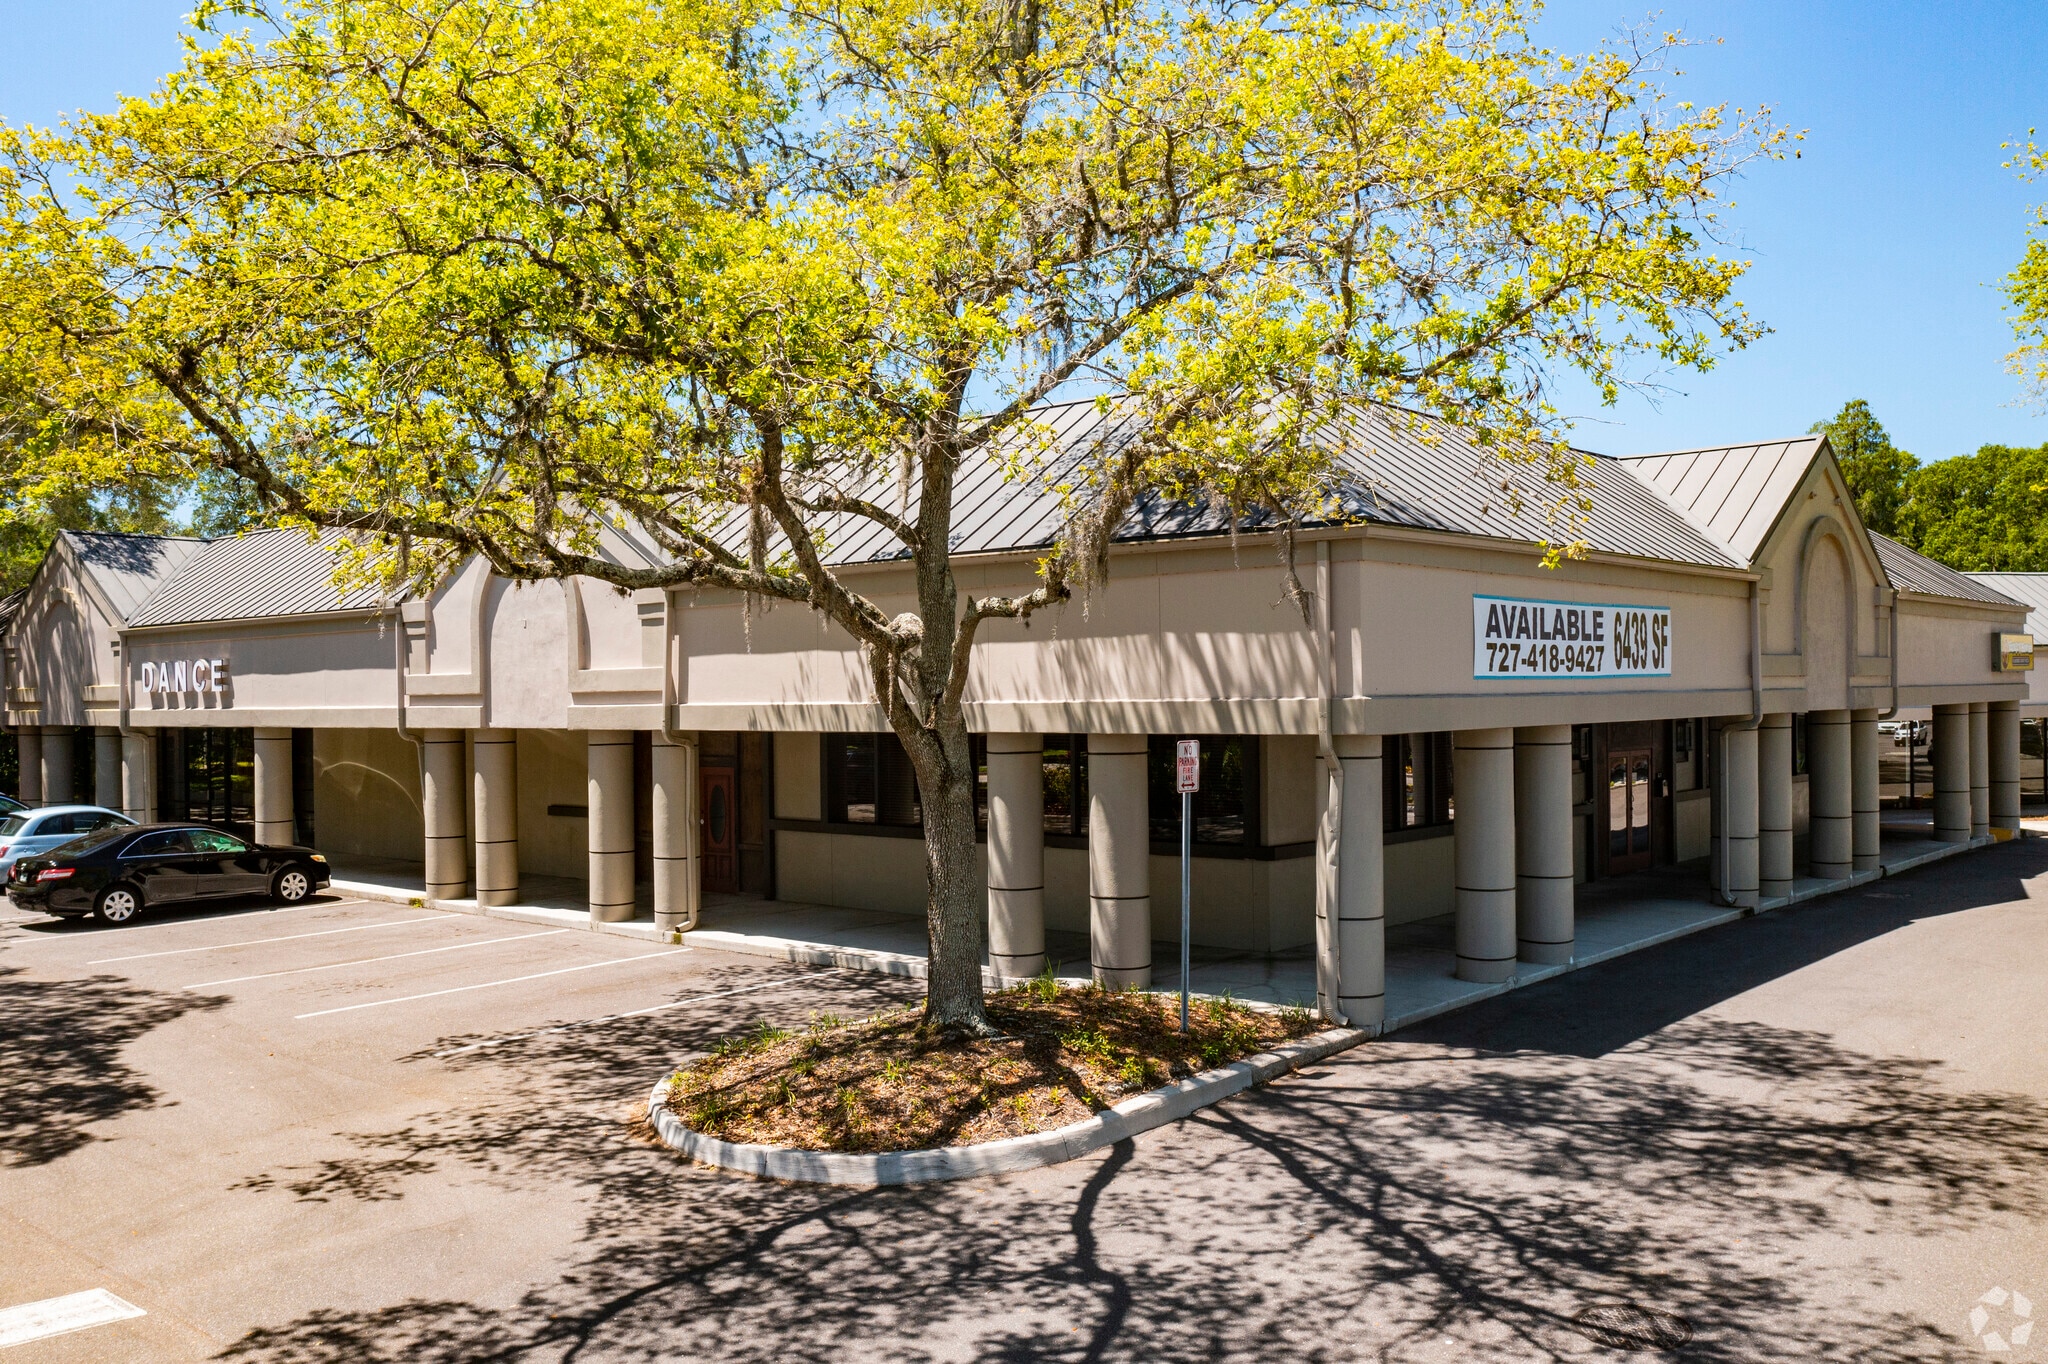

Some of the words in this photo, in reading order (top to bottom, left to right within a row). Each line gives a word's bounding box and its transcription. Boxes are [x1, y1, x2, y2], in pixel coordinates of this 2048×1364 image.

[1485, 604, 1604, 641] AVAILABLE
[1614, 612, 1648, 670] 6439
[1652, 613, 1668, 669] SF
[1486, 643, 1604, 672] 727-418-9427
[141, 659, 223, 692] DANCE
[1178, 756, 1197, 766] PARKING
[1183, 745, 1193, 755] NO
